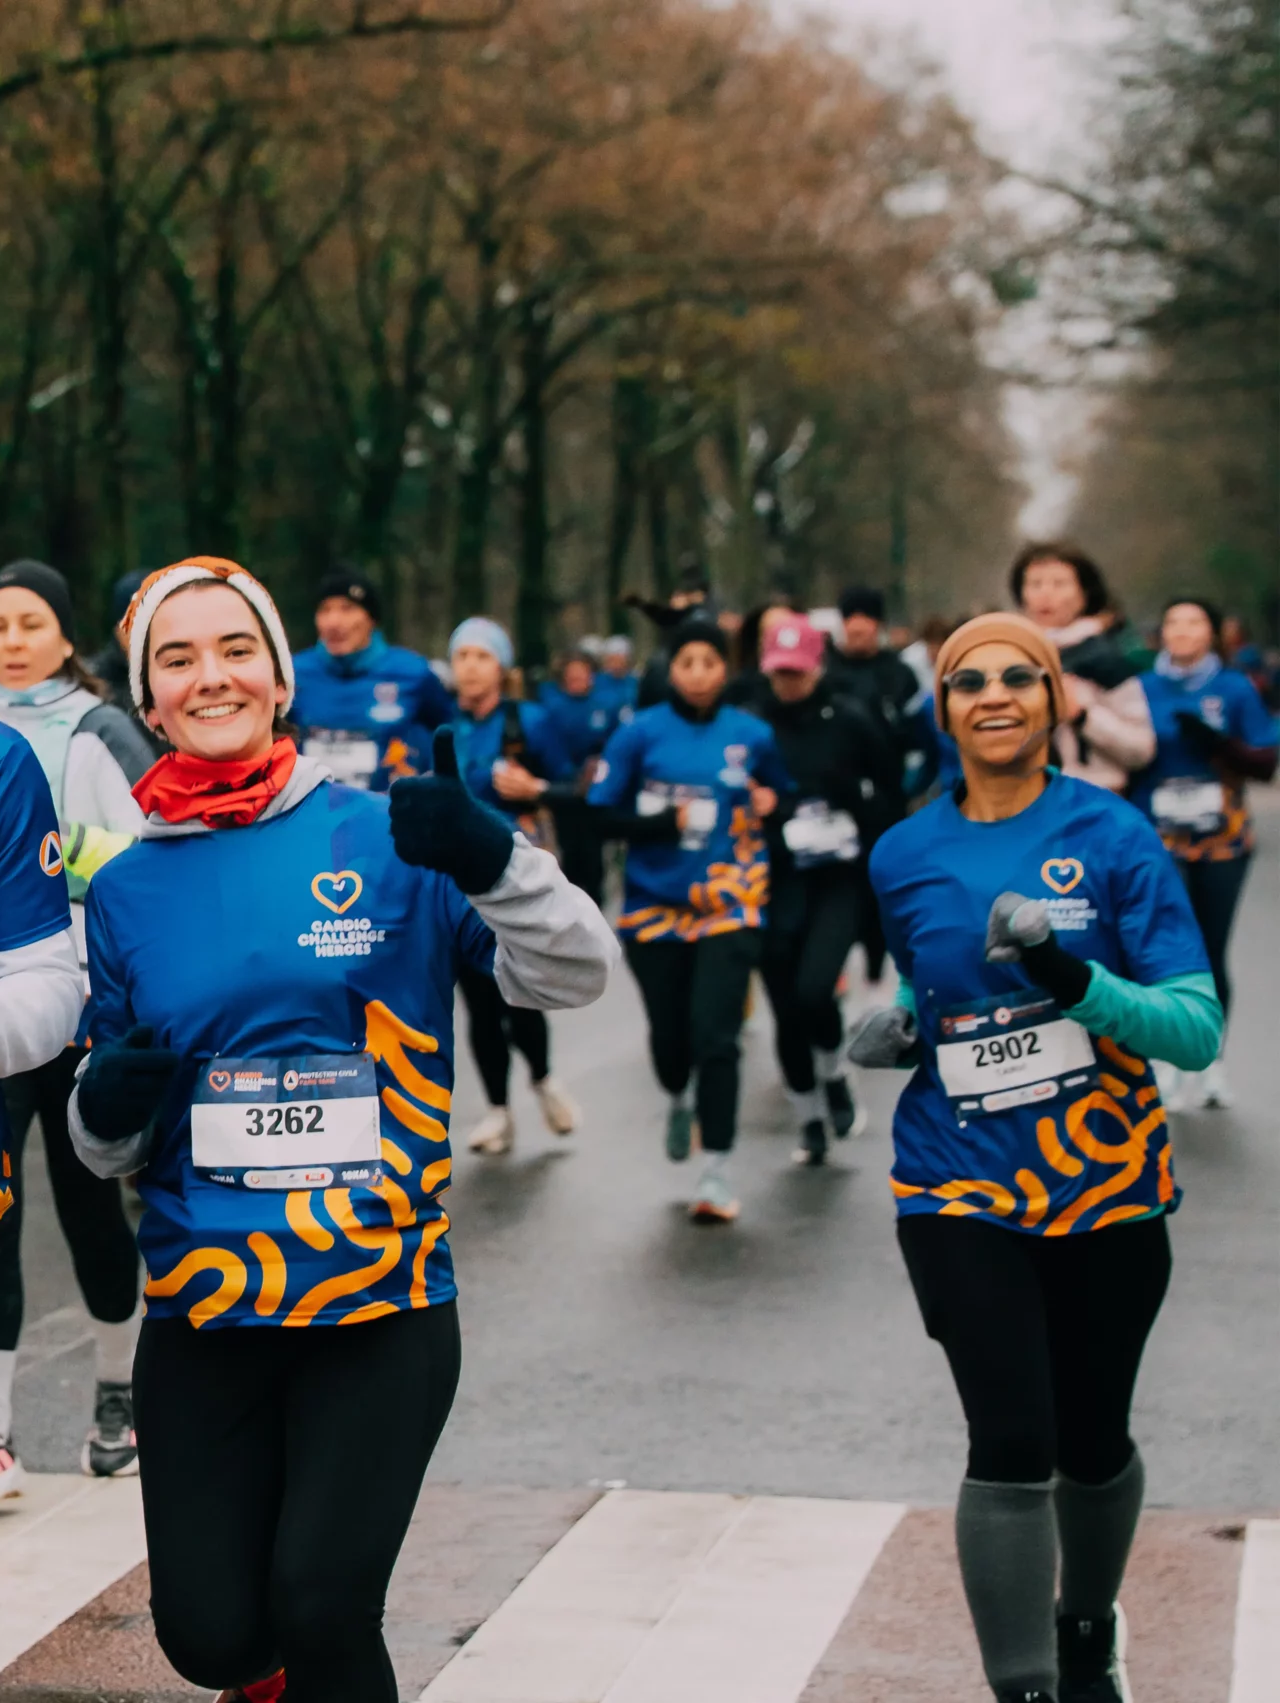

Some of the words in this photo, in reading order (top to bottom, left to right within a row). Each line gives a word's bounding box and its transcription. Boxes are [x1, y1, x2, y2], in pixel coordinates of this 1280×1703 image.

[311, 918, 372, 933] CARDIO
[297, 930, 386, 947] CHALLENGE
[315, 942, 372, 958] HEROES
[972, 1031, 1042, 1067] 2902
[245, 1105, 325, 1136] 3262
